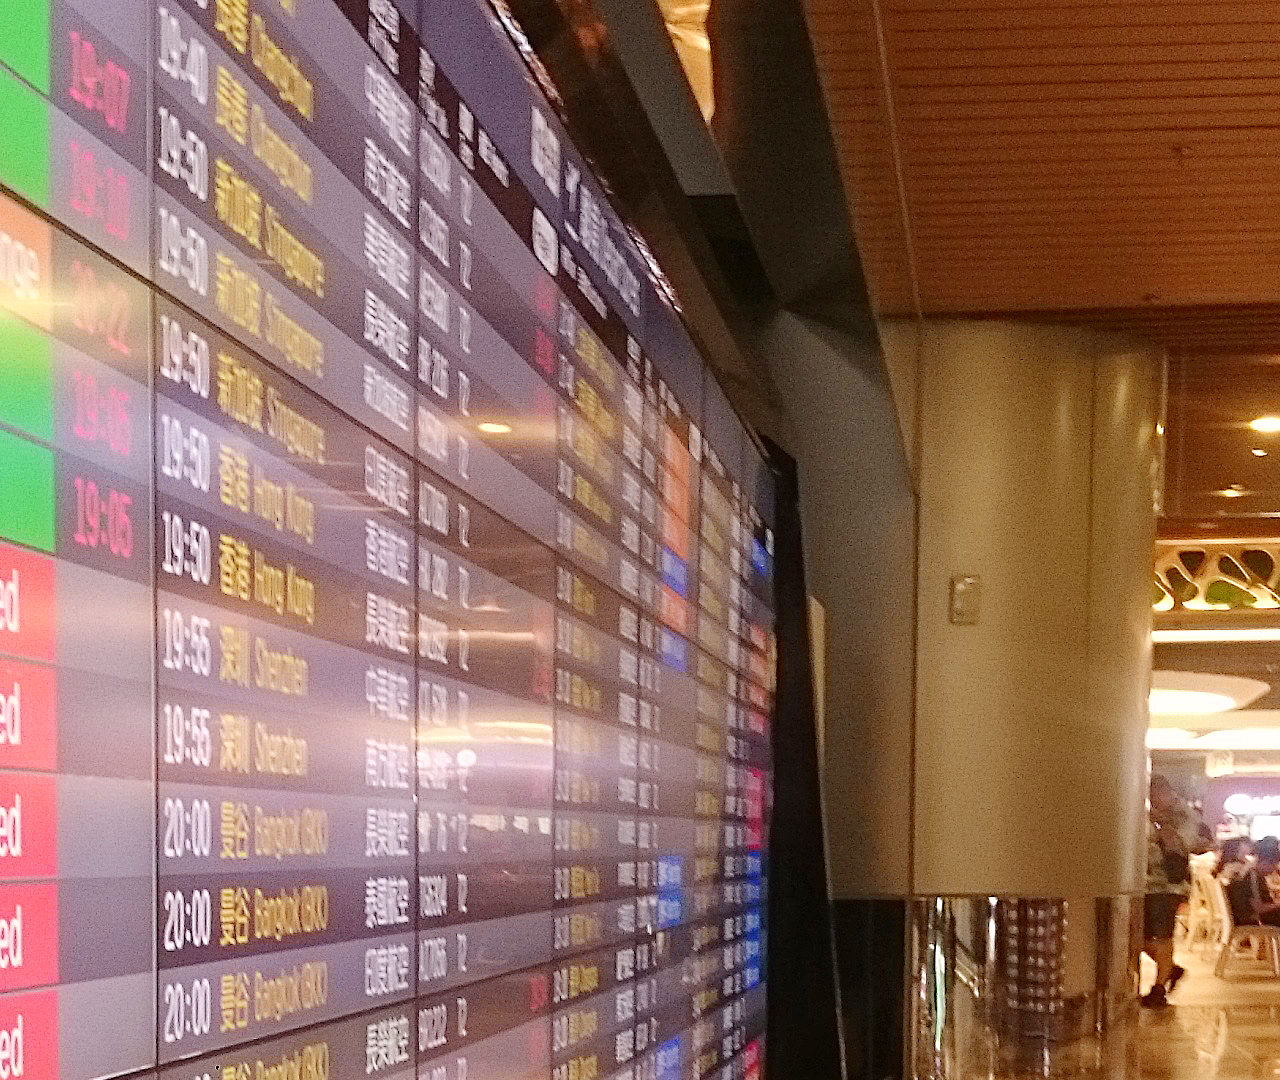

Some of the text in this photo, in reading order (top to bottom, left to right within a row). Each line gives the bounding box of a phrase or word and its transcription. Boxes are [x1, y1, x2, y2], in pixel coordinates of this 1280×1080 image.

[160, 315, 210, 399] 19:50
[161, 414, 210, 492] 19:50
[161, 511, 211, 585] 19:50
[163, 608, 211, 676] 19:55
[164, 704, 211, 766] 19:55
[164, 798, 212, 857] 20:00
[164, 889, 212, 951] 20:00
[164, 978, 212, 1043] 20:00
